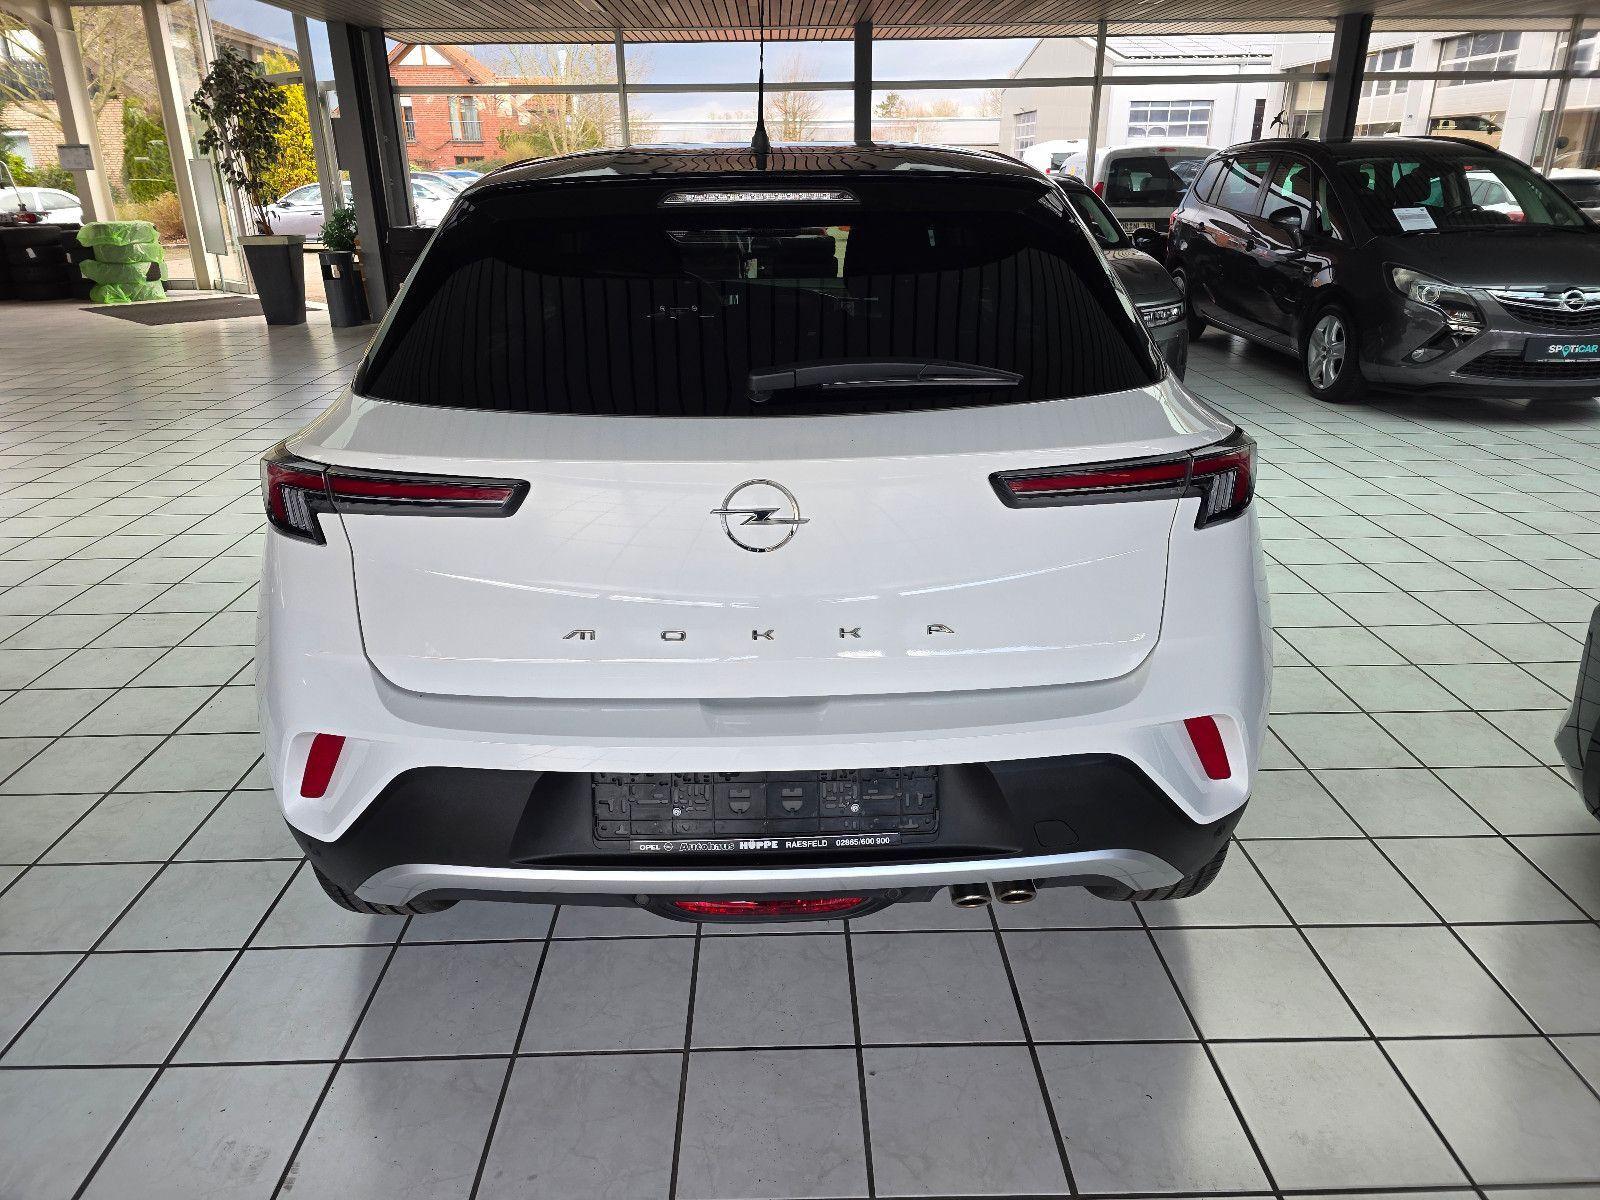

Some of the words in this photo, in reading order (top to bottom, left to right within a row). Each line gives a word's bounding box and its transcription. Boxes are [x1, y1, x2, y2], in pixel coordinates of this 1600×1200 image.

[562, 624, 955, 641] MOKKA
[679, 842, 735, 851] Autohaus
[739, 840, 779, 850] HÜPPE
[785, 840, 828, 848] RAESFELD
